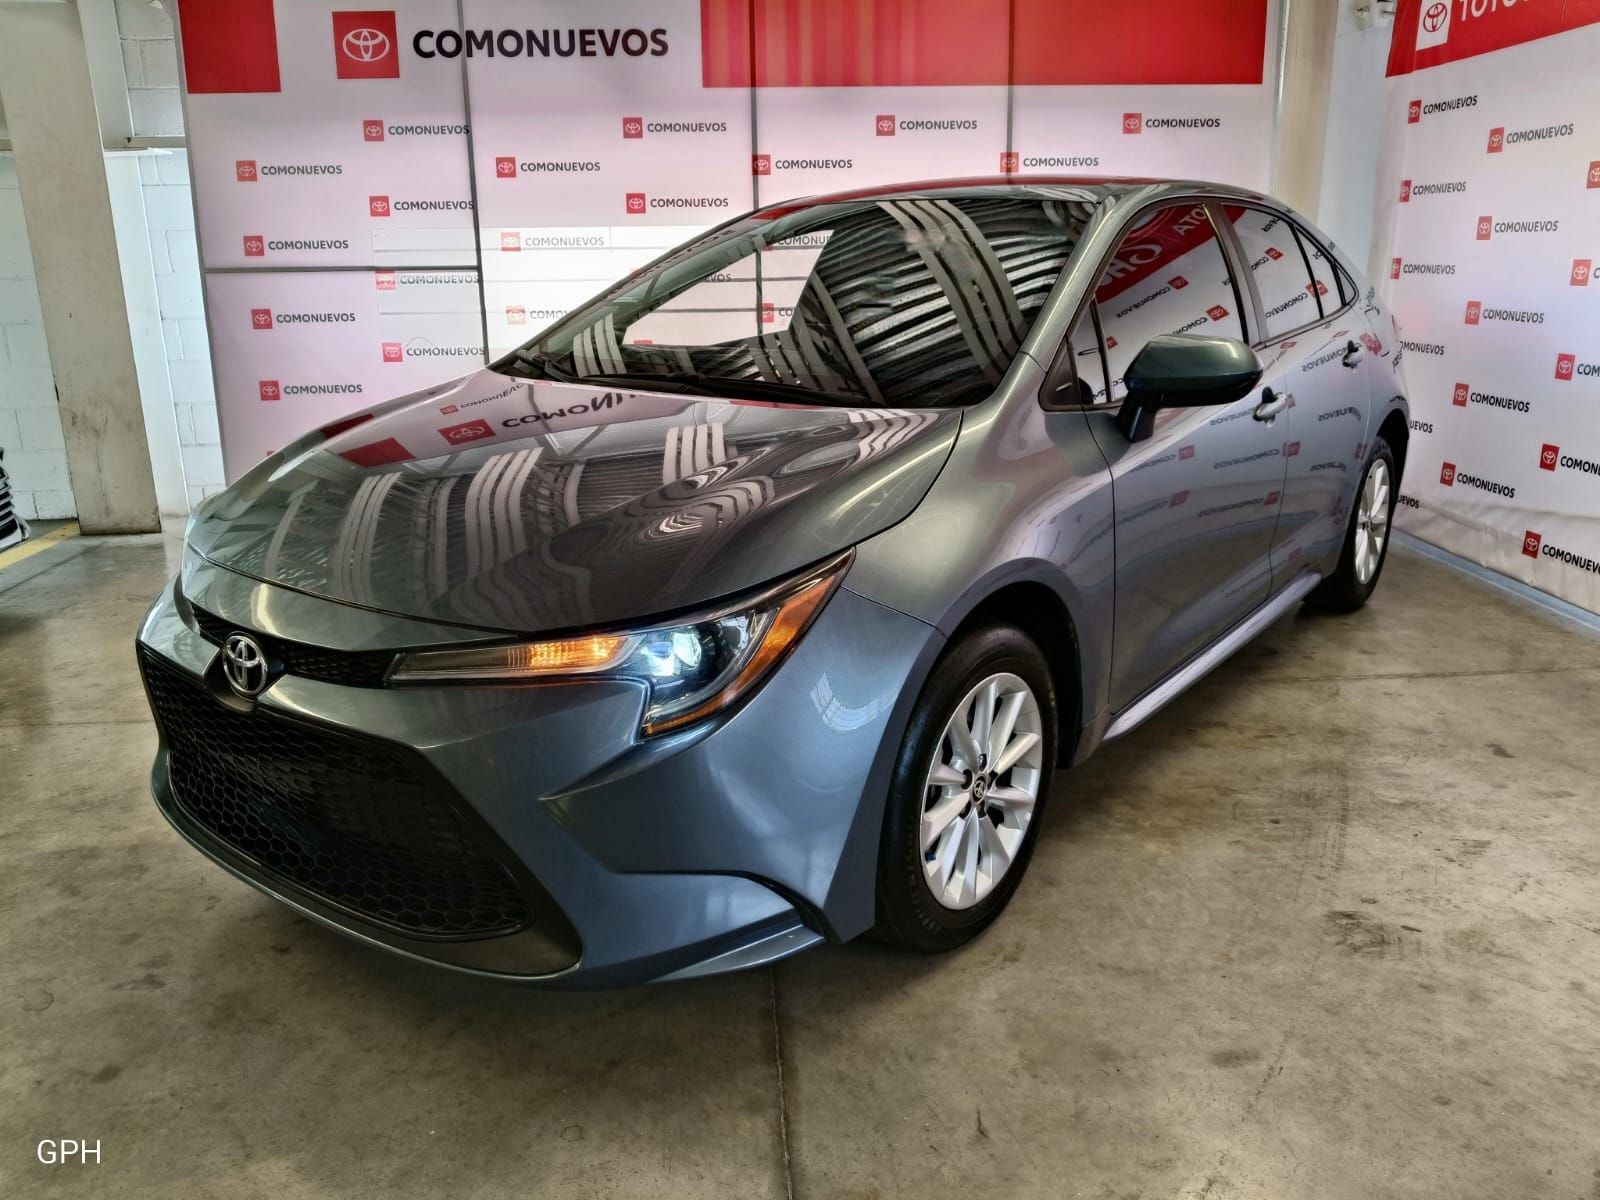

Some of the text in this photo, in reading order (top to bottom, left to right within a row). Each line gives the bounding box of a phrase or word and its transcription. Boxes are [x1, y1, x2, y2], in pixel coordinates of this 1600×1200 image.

[412, 28, 669, 59] COMONUEVOS
[1423, 95, 1478, 115] COMONUEVOS
[647, 122, 727, 133] COMONUEVOS
[899, 119, 978, 131] COMONUEVOS
[1145, 117, 1221, 129] COMONUEVOS
[388, 124, 470, 136] COMONUEVOS
[1506, 123, 1574, 144] COMONUEVOS
[520, 161, 601, 173] COMONUEVOS
[775, 158, 853, 171] COMONUEVOS
[1023, 156, 1100, 168] COMONUEVOS
[261, 164, 343, 176] COMONUEVOS
[1412, 181, 1466, 196] COMONUEVOS
[394, 200, 474, 212] COMONUEVOS
[650, 198, 729, 209] COMONUEVOS
[1494, 220, 1559, 233] COMONUEVOS
[268, 239, 349, 251] COMONUEVOS
[525, 236, 604, 248] COMONUEVOS
[1403, 263, 1456, 275] COMONUEVOS
[400, 274, 480, 285] COMONUEVOS
[276, 313, 356, 324] COMONUEVOS
[1482, 308, 1545, 324] COMONUEVOS
[406, 346, 485, 358] COMONUEVOS
[283, 384, 363, 395] COMONUEVOS
[1470, 392, 1530, 413] COMONUEVOS
[1457, 472, 1515, 499] COMONUEVOS
